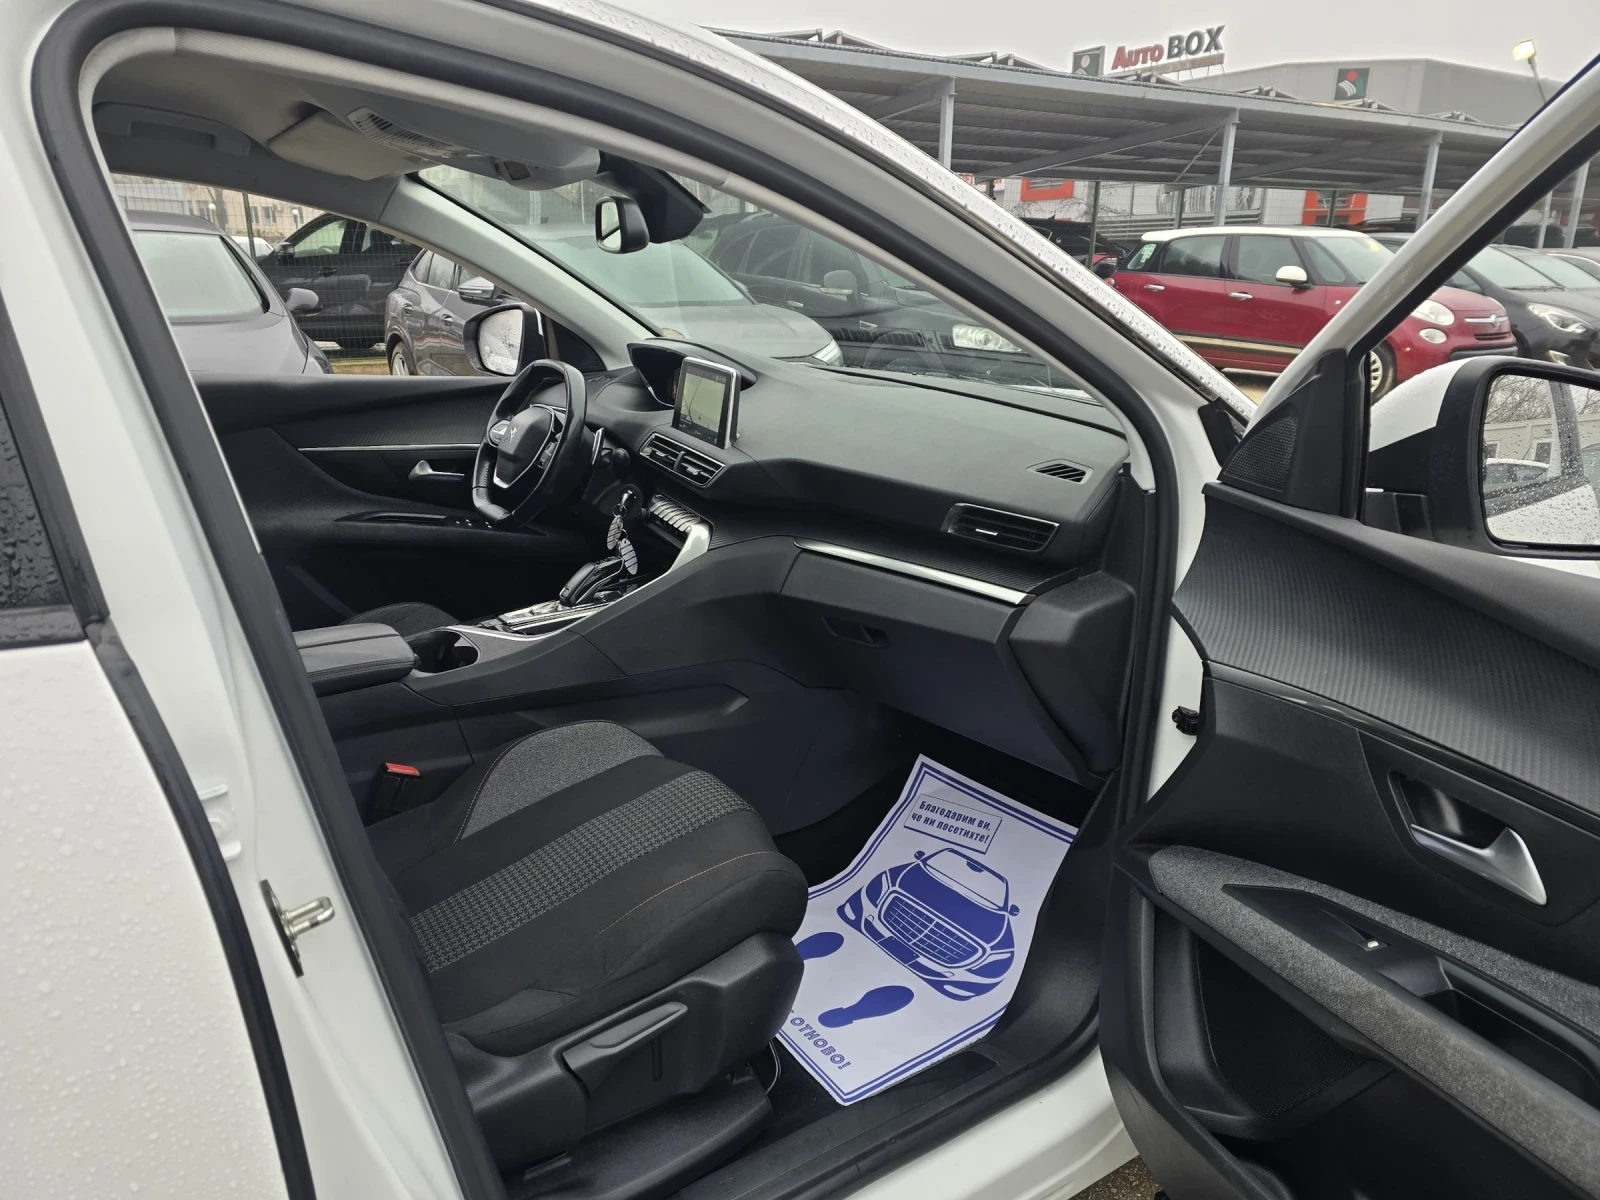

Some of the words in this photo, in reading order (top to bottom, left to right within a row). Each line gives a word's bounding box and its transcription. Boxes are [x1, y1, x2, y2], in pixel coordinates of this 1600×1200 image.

[1166, 25, 1226, 59] BOX
[911, 811, 922, 822] че
[923, 815, 935, 827] ни
[936, 820, 990, 844] посетихте!
[919, 800, 976, 826] Благодарим
[977, 819, 992, 831] ви,
[790, 1017, 851, 1070] ОТНОВО!
